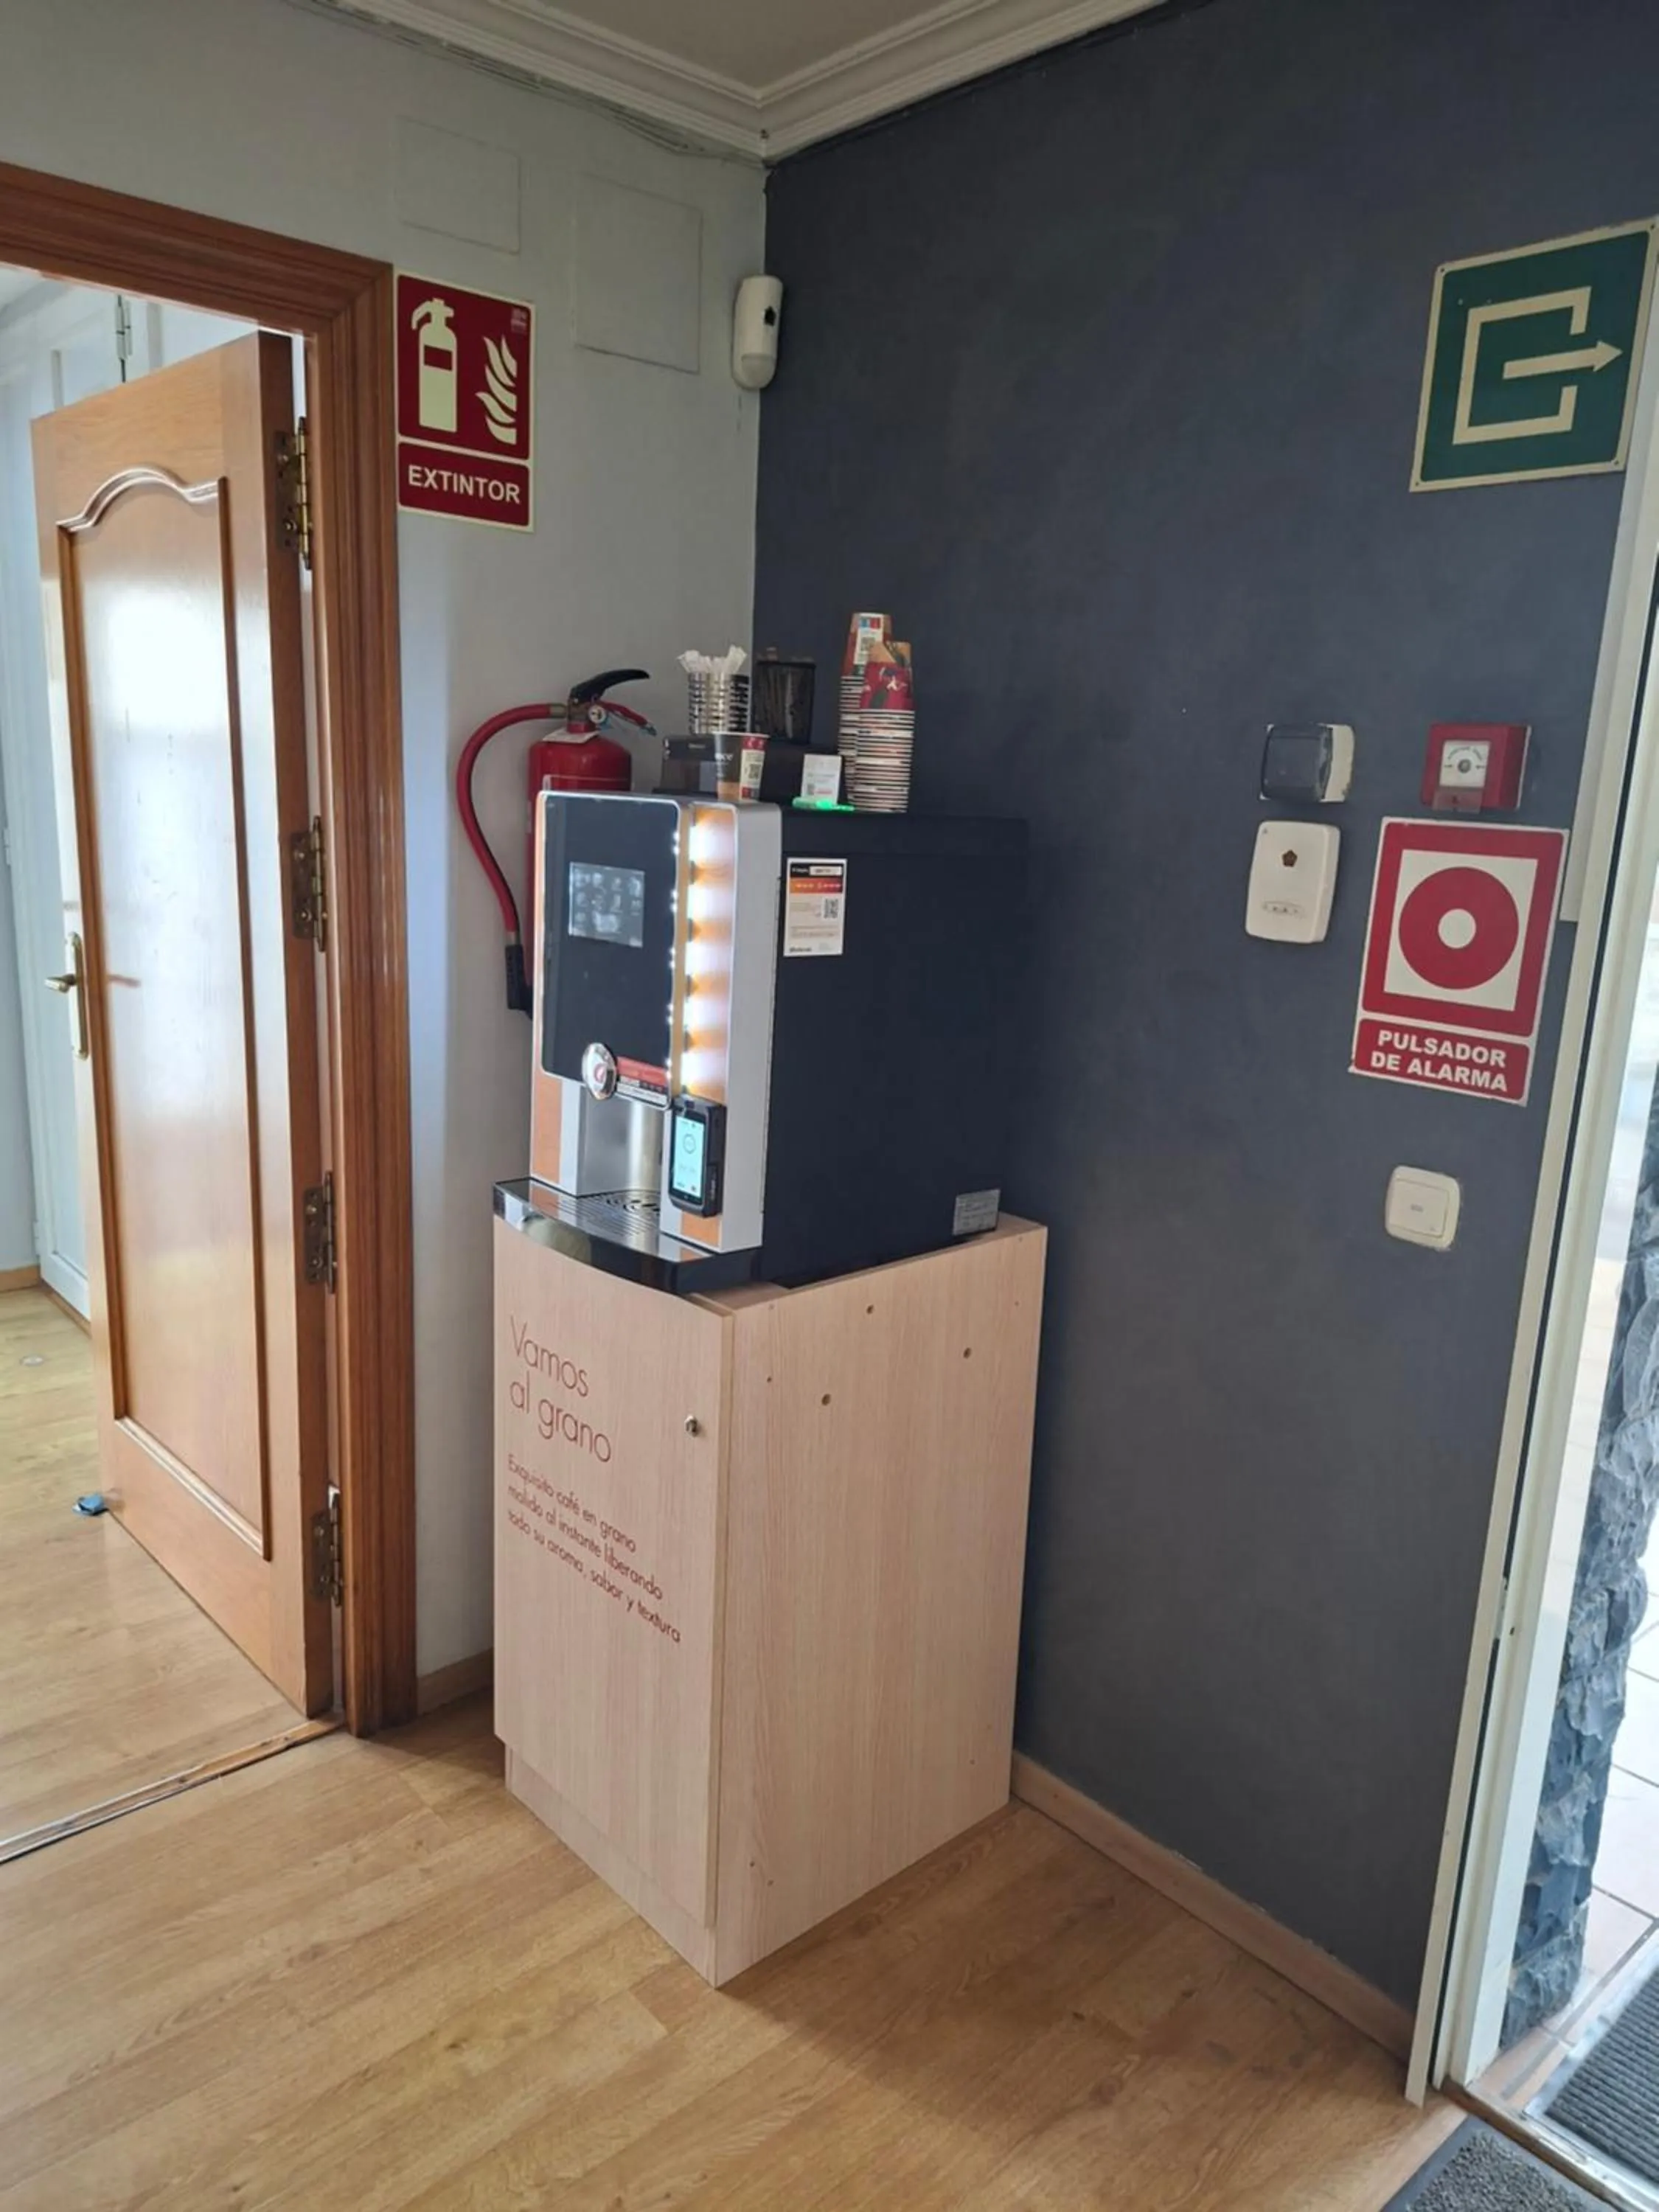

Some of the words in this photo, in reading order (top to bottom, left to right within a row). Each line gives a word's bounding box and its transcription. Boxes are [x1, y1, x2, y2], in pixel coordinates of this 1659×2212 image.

[408, 465, 521, 504] EXTINTOR
[1370, 1051, 1400, 1071] DE
[1407, 1057, 1508, 1092] ALARMA
[1377, 1029, 1507, 1068] PULSADOR
[510, 1315, 589, 1397] Vamos
[509, 1371, 530, 1414] al
[538, 1399, 611, 1463] grano
[508, 1453, 554, 1498] Exquisito
[557, 1491, 580, 1516] café
[582, 1509, 597, 1526] en
[599, 1520, 636, 1554] grano
[508, 1485, 543, 1517] molido
[546, 1508, 557, 1526] al
[559, 1514, 602, 1558] instante
[604, 1542, 663, 1600] liberando
[508, 1509, 531, 1535] todo
[534, 1529, 546, 1545] su
[591, 1569, 624, 1601] sabor
[626, 1594, 635, 1613] y
[637, 1599, 681, 1644] textura
